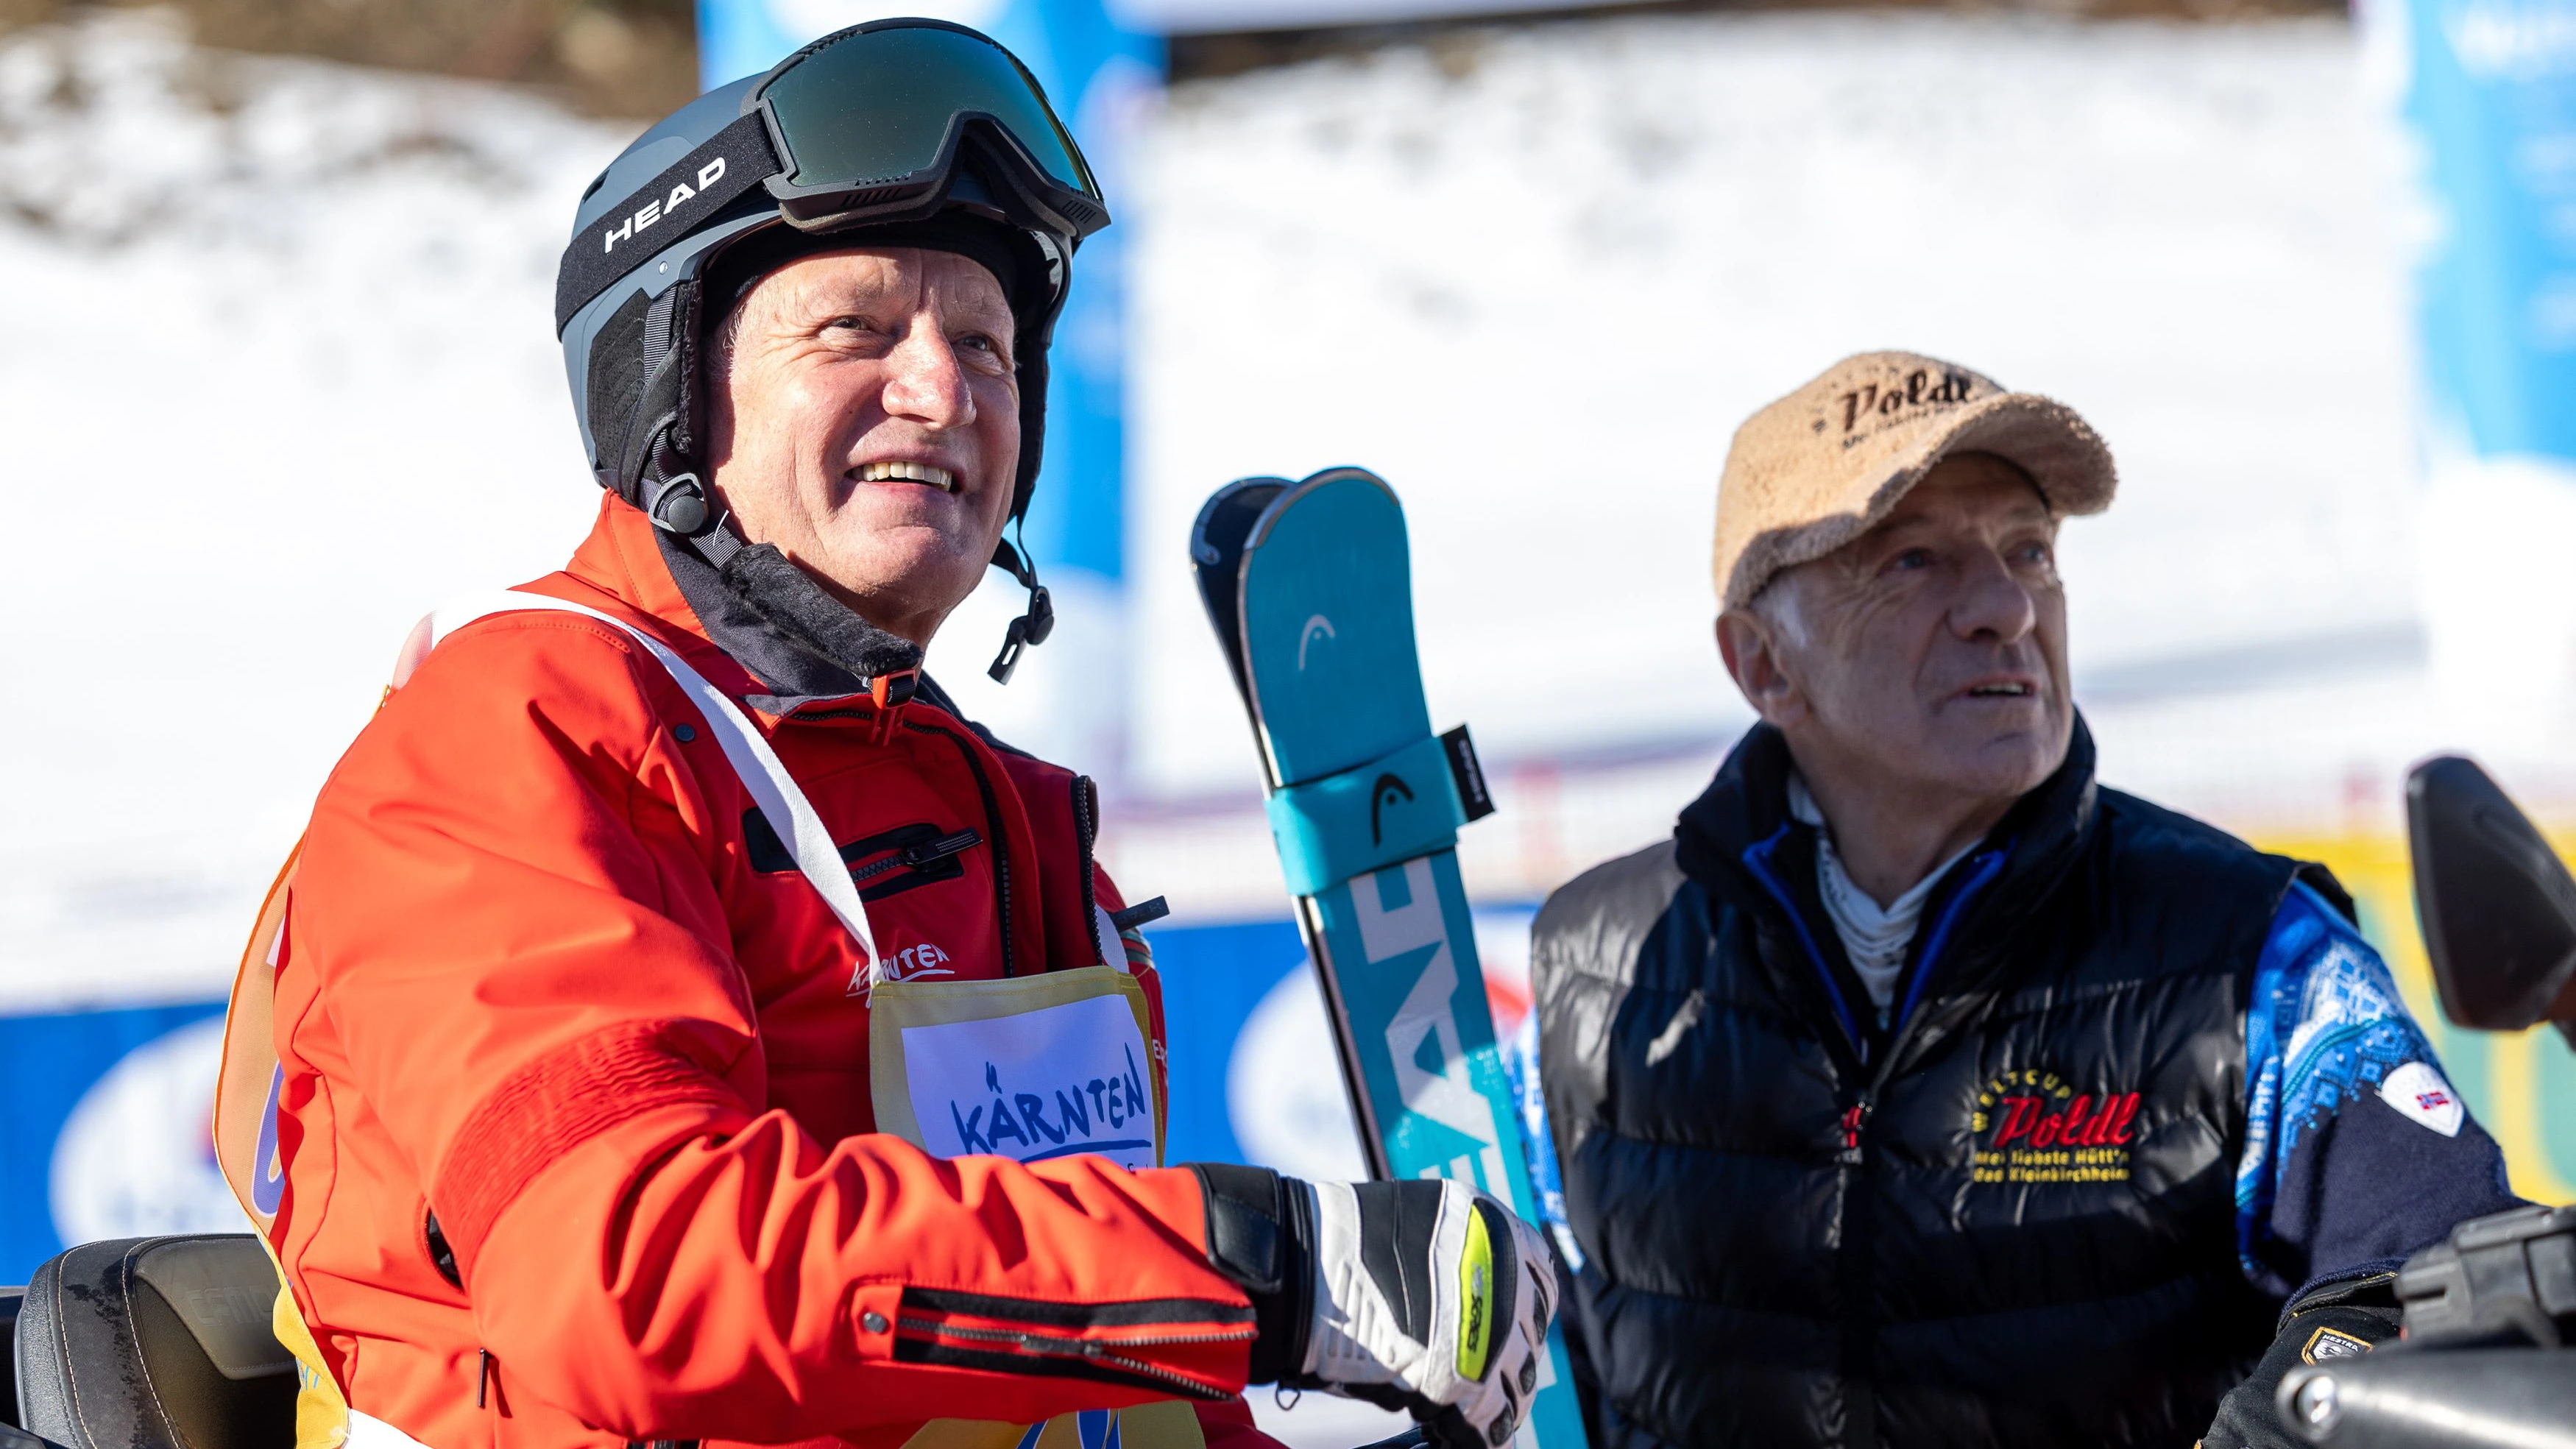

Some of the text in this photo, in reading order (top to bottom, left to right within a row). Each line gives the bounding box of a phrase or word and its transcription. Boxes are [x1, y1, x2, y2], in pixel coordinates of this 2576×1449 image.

[605, 157, 726, 254] HEAD
[847, 943, 950, 992] KRNTEN
[951, 1042, 1146, 1156] KÄRNTEN
[1993, 1091, 2141, 1149] Poldl
[2322, 1334, 2358, 1352] HESTRA
